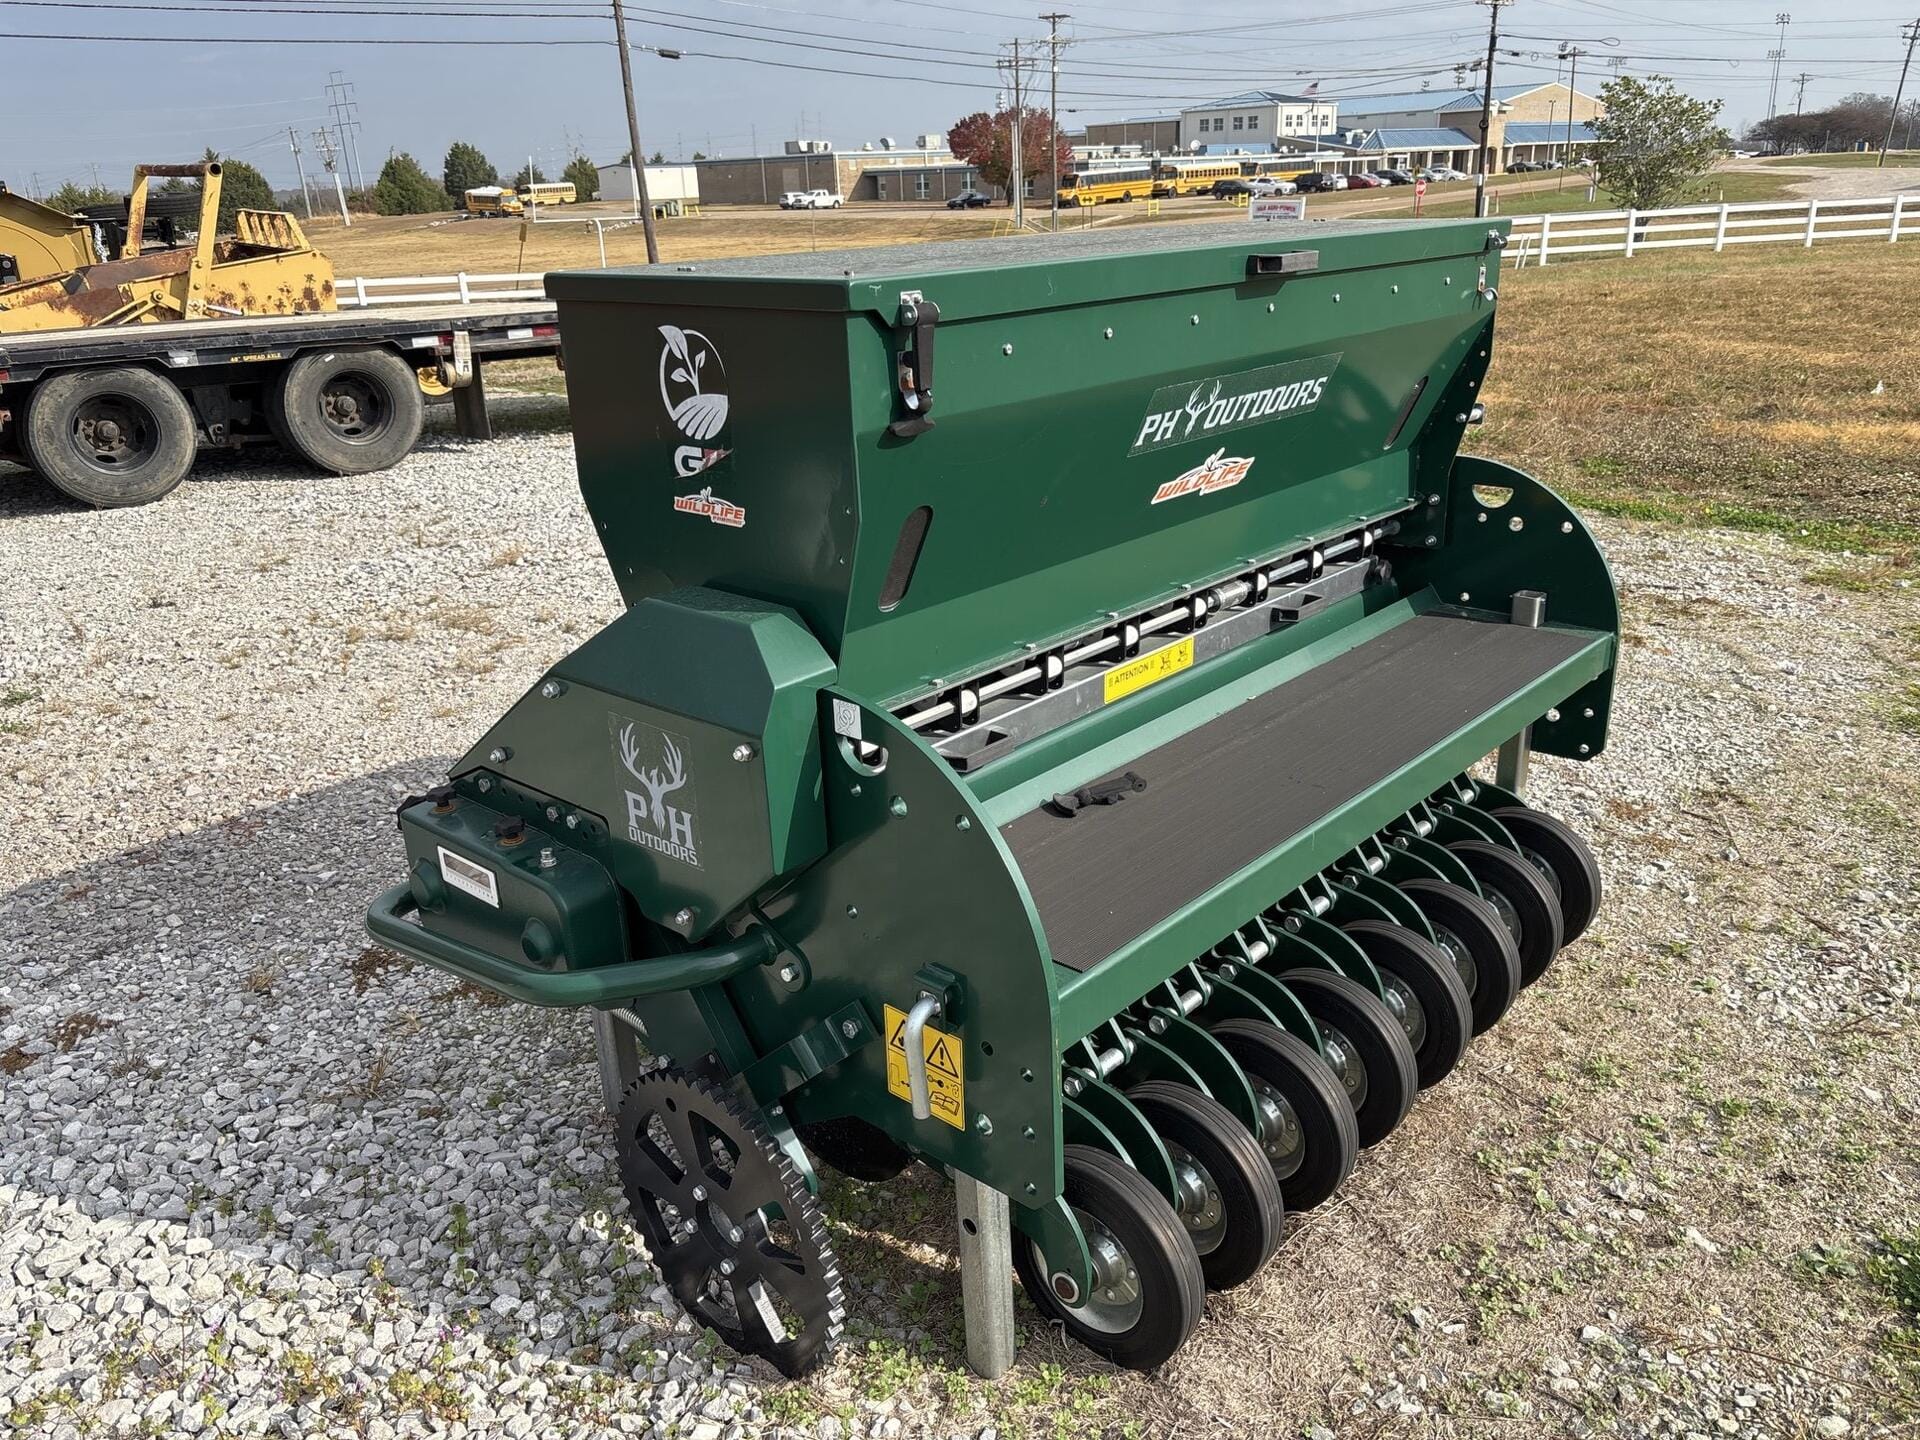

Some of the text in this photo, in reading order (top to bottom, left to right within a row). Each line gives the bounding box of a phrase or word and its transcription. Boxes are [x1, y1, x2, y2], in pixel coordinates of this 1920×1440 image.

[243, 353, 266, 362] SPREAD
[1134, 376, 1328, 447] PH OUTDOORS
[1155, 461, 1251, 500] WILDLIFE
[676, 499, 744, 520] WILDLIFE
[1114, 663, 1149, 685] ATTENTION
[628, 826, 698, 866] OUTDOORS
